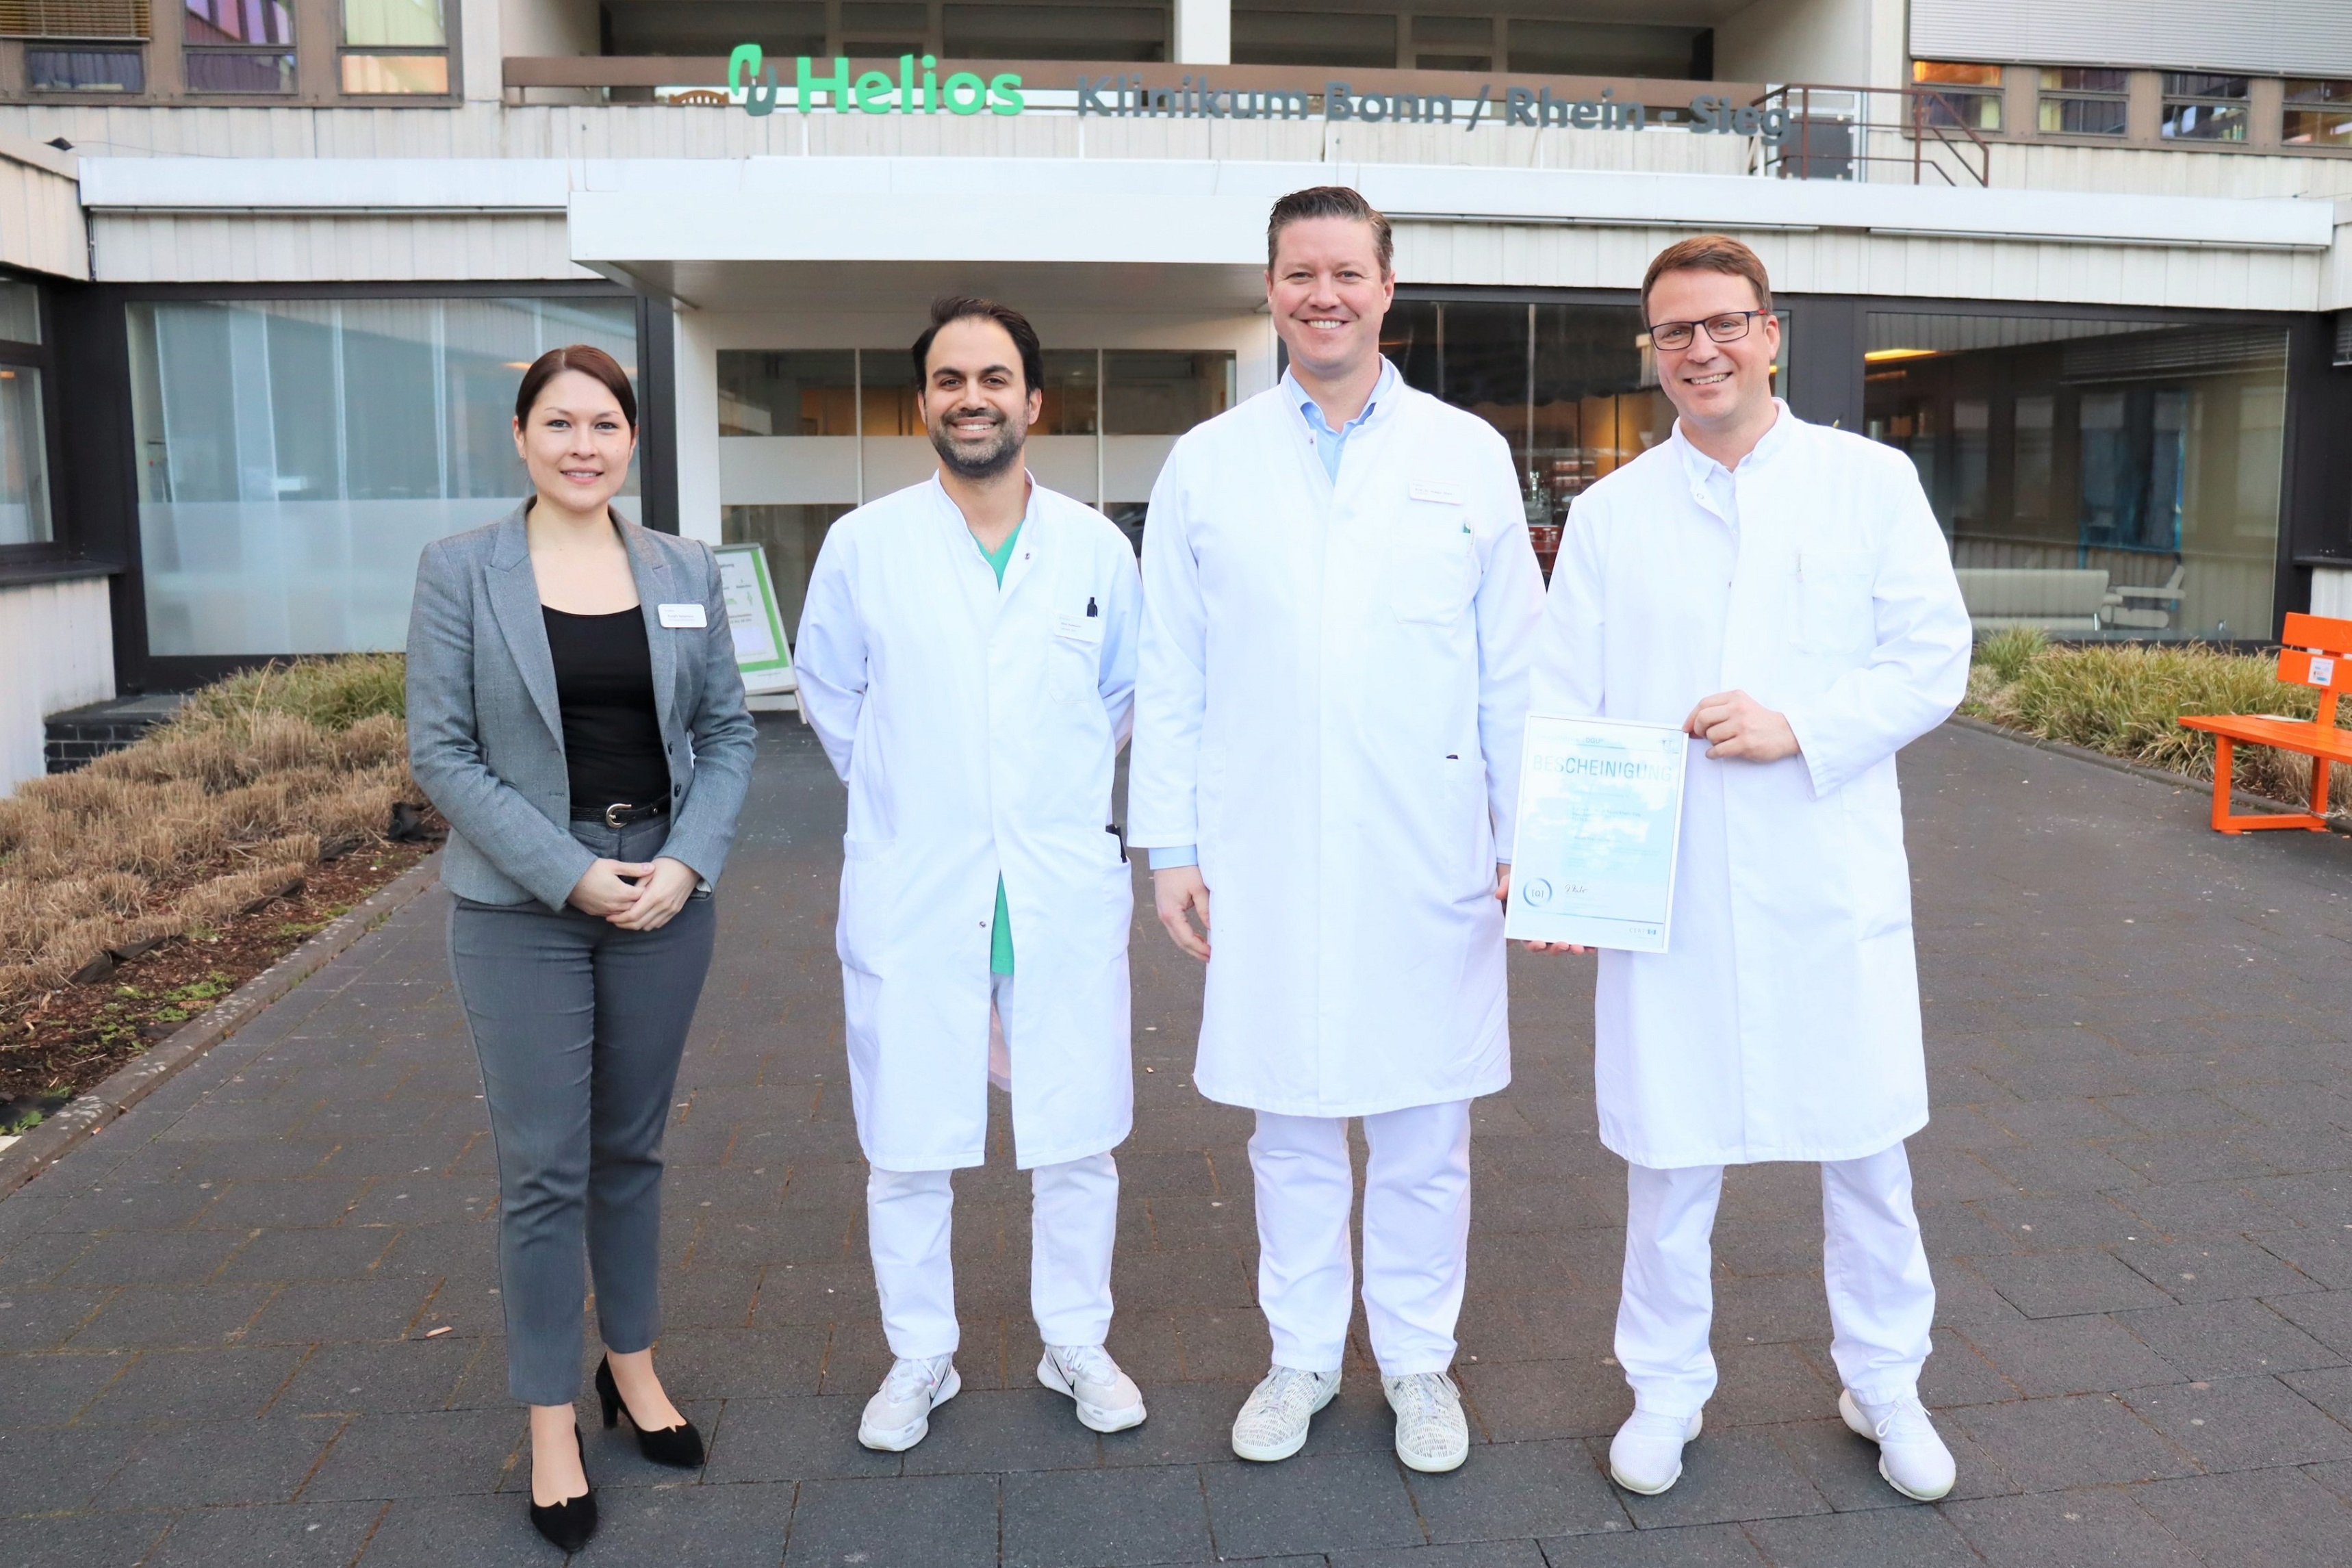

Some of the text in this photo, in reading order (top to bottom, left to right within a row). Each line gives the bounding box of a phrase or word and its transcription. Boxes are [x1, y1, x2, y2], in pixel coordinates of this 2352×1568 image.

[797, 54, 1025, 116] Helios
[1077, 73, 1308, 120] Klinikum
[1325, 81, 1453, 123] Bonn
[1533, 754, 1672, 782] BESCHEINIGUNG
